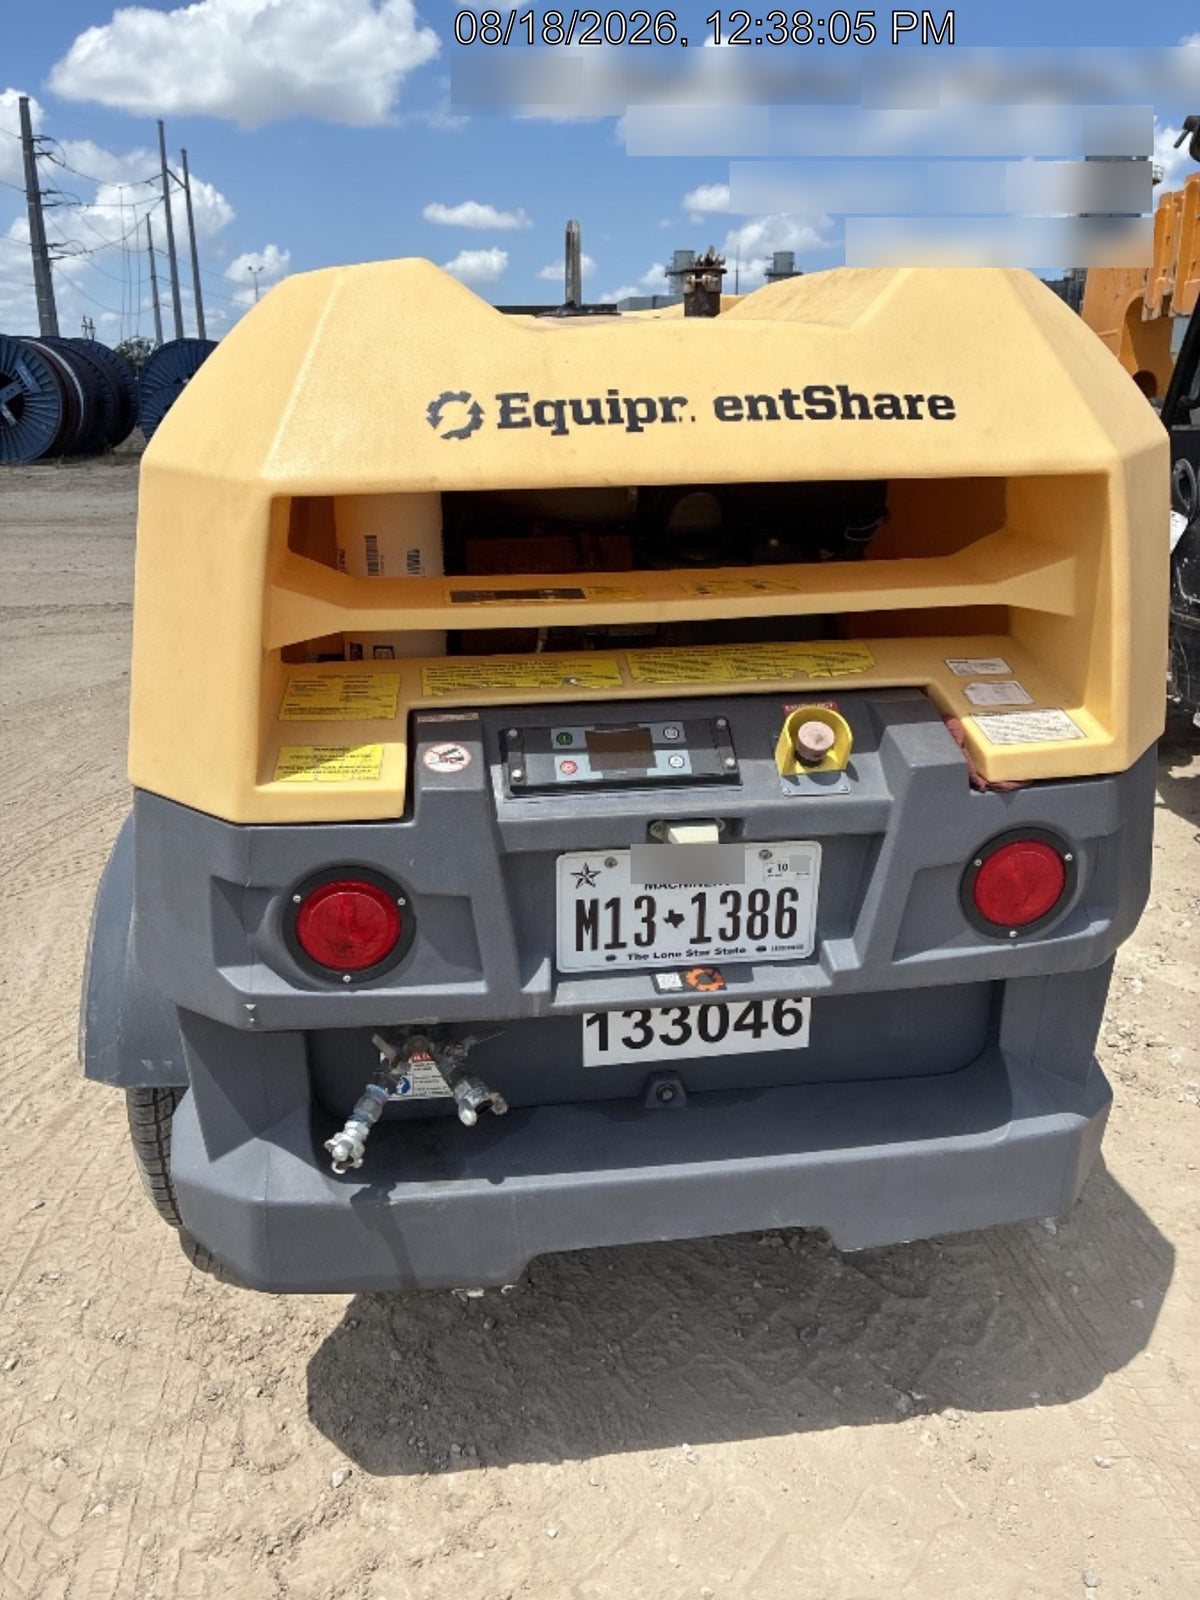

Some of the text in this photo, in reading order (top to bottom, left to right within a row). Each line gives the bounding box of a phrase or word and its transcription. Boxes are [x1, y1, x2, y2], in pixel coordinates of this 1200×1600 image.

[575, 887, 799, 952] M13 1386
[653, 951, 682, 960] Lone
[586, 997, 803, 1052] 133046
